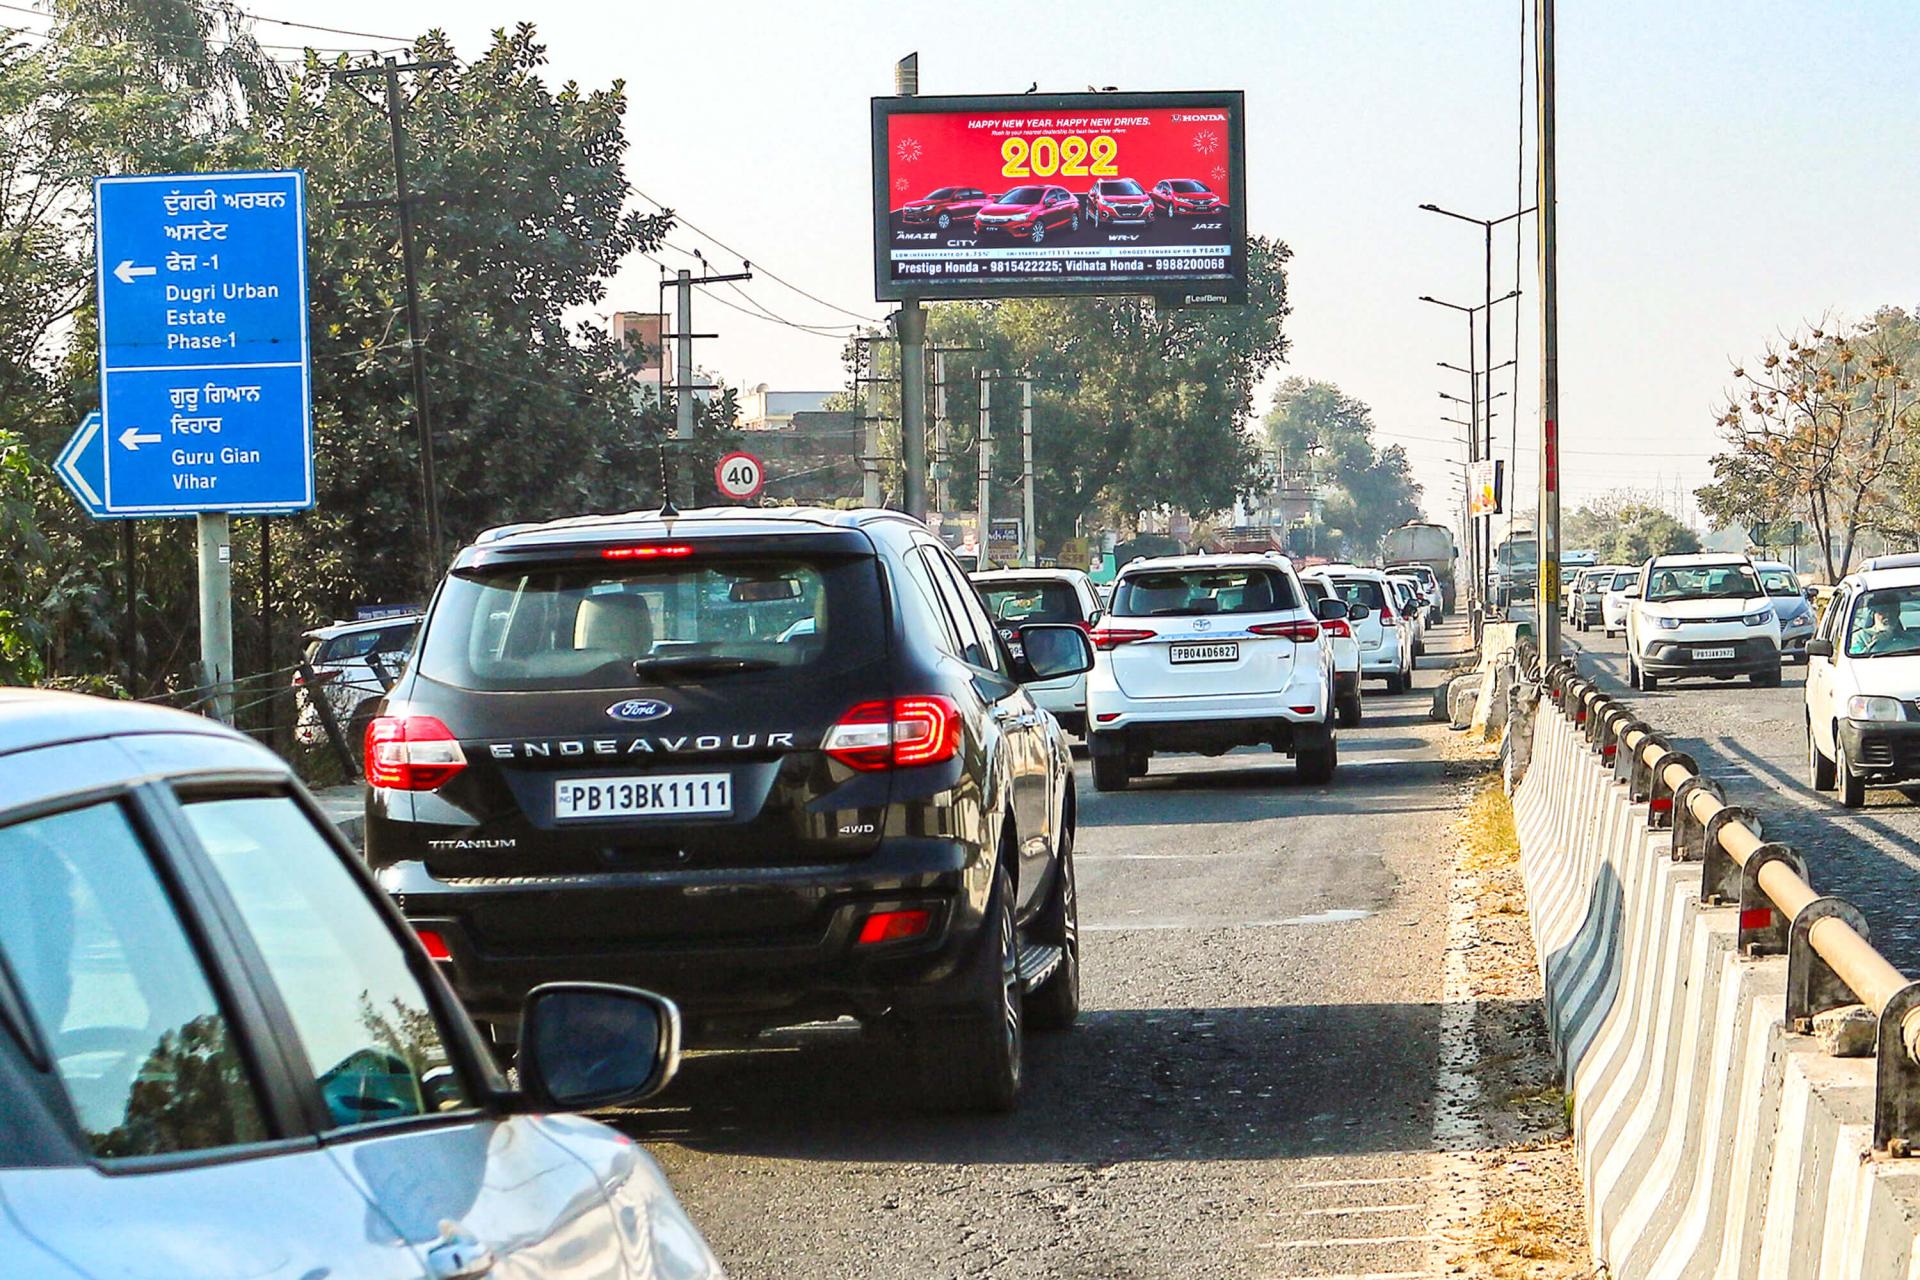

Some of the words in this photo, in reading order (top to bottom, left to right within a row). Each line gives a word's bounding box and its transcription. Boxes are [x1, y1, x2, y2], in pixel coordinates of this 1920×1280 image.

[968, 120, 1000, 128] HAPPY
[1002, 119, 1024, 127] NEW
[1027, 119, 1053, 127] YEAR.
[1056, 118, 1088, 127] HAPPY
[1090, 118, 1112, 126] NEW
[1114, 117, 1151, 126] DRIVES.
[1182, 114, 1226, 122] HONDA
[1001, 135, 1119, 177] 2022
[163, 188, 217, 216] ਦੁੱਗਰੀ
[224, 191, 286, 209] ਅਰਬਨ
[164, 220, 228, 242] ਅਸਟੇਟ
[896, 232, 937, 240] AMAZE
[947, 239, 978, 247] CITY
[166, 253, 198, 273] ਫੇਜ਼
[898, 262, 942, 274] Prestige
[945, 261, 979, 273] Honda
[990, 261, 1062, 273] 9815422225;
[1065, 259, 1107, 271] Vidhata
[1110, 259, 1144, 271] Honda
[1155, 258, 1225, 271] 9988200068
[166, 285, 216, 304] Dugri
[224, 283, 279, 299] Urban
[1191, 294, 1227, 304] LeafBerry
[167, 310, 226, 325] Estate
[167, 333, 237, 350] Phase-1
[169, 387, 199, 412] ਗੁਰੂ
[204, 384, 261, 403] ਗਿਆਨ
[170, 415, 222, 435] ਵਿਹਾਰ
[172, 449, 216, 466] Guru
[220, 447, 260, 464] Gian
[172, 474, 217, 490] Vihar
[727, 466, 753, 485] 40
[1178, 646, 1236, 660] PB04AD6827
[621, 701, 657, 718] Ford
[489, 731, 794, 759] ENDEAVOUR
[572, 780, 726, 811] PB13BK1111
[839, 822, 875, 835] 4WD
[428, 837, 516, 850] TITANIUM
